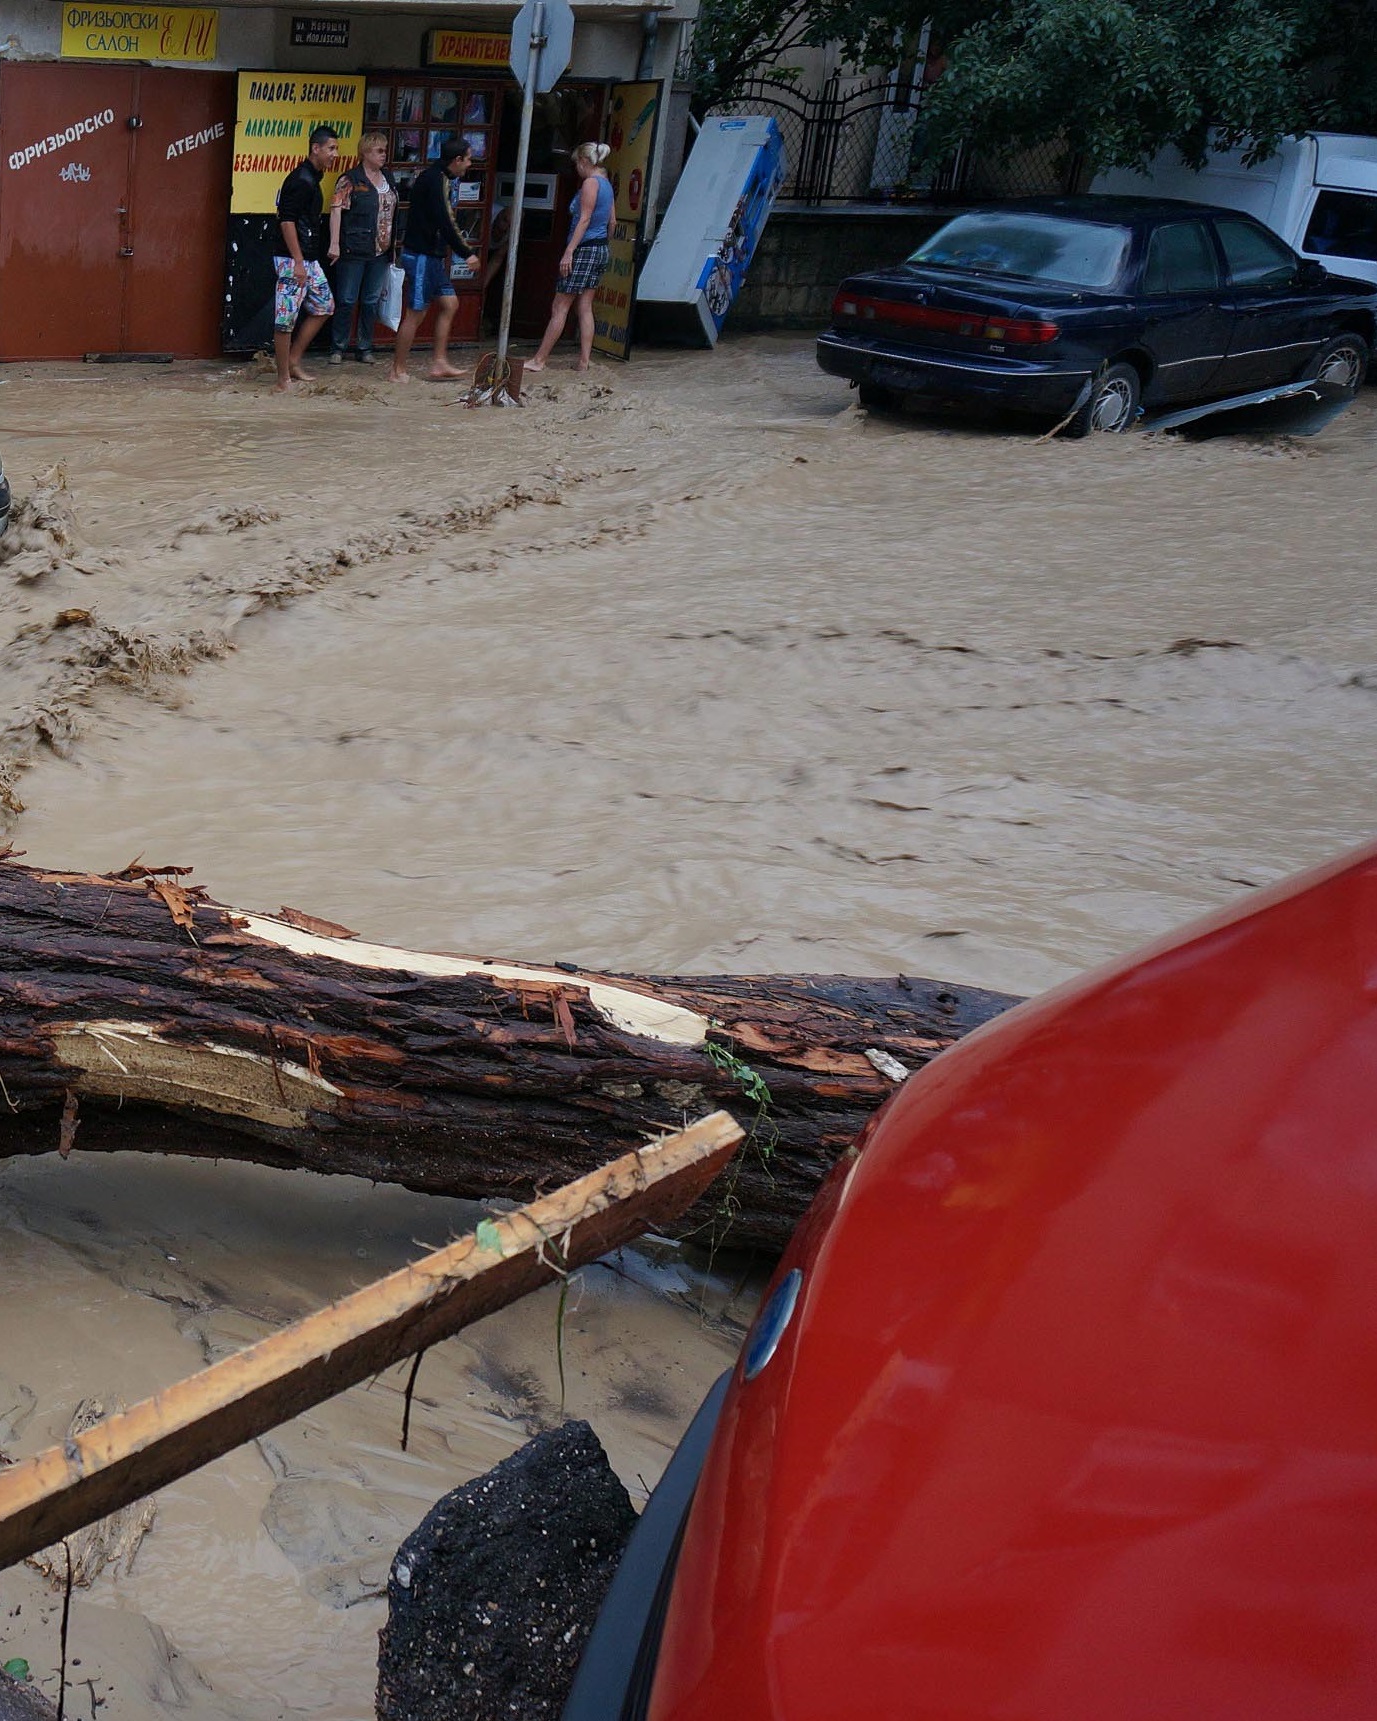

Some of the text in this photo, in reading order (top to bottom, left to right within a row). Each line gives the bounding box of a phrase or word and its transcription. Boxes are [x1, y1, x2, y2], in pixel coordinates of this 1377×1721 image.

[67, 8, 158, 30] ФРИЗЬОРСКИ
[86, 34, 139, 52] САЛОН
[439, 35, 512, 60] ХРАНИТЕЛЕ
[249, 81, 357, 104] ПЛОДОВЕ, ЗЕЛЕНЧУЦИ
[8, 108, 115, 170] ФРИЗЬОРСКО
[245, 119, 303, 138] АЛКОХОЛНИ
[166, 122, 225, 160] АТЕЛИЕ
